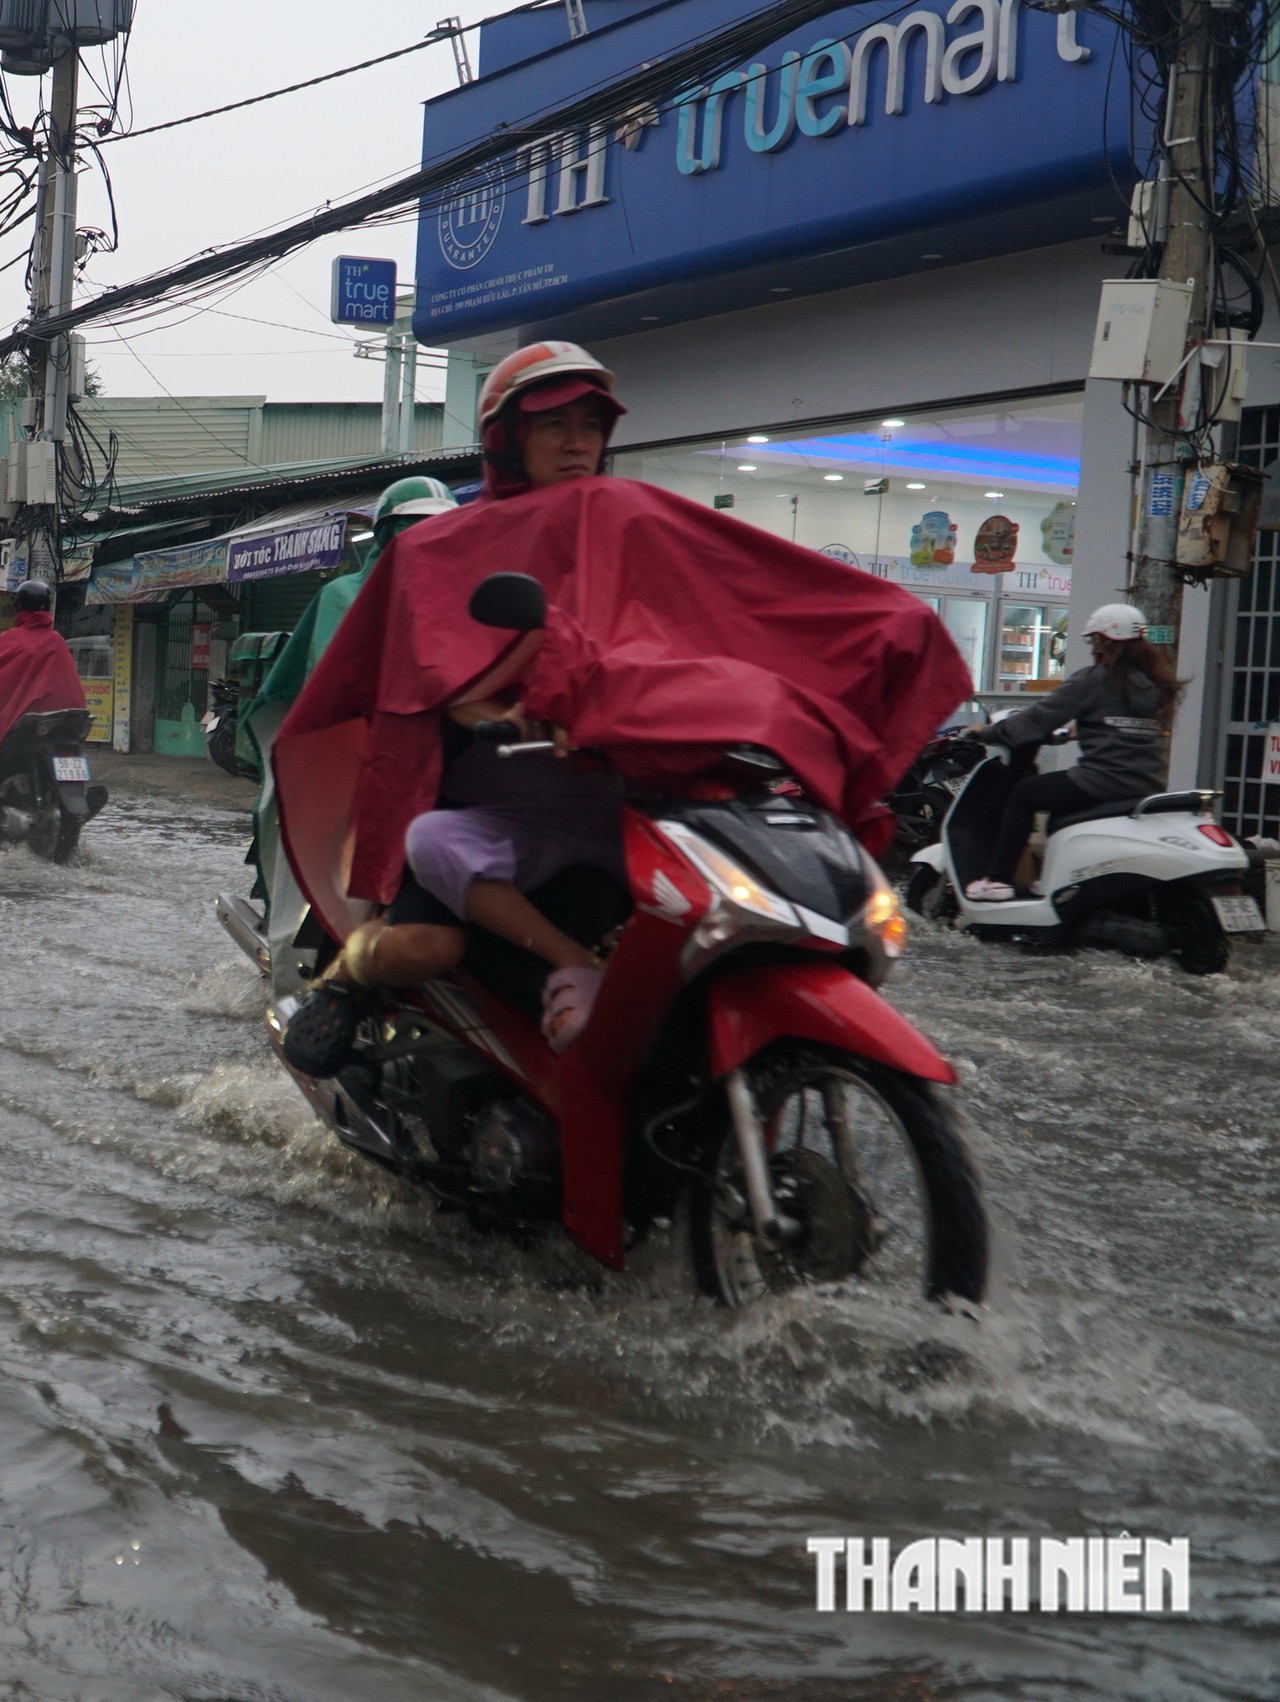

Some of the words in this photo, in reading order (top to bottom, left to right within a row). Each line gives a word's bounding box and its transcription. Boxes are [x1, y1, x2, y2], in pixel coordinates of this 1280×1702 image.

[517, 122, 612, 225] TH
[345, 266, 361, 276] TH
[345, 278, 389, 301] true
[346, 302, 389, 319] mart
[253, 546, 272, 566] TÓC
[273, 531, 310, 561] THANH
[307, 524, 340, 554] SANG
[1017, 571, 1038, 589] TH
